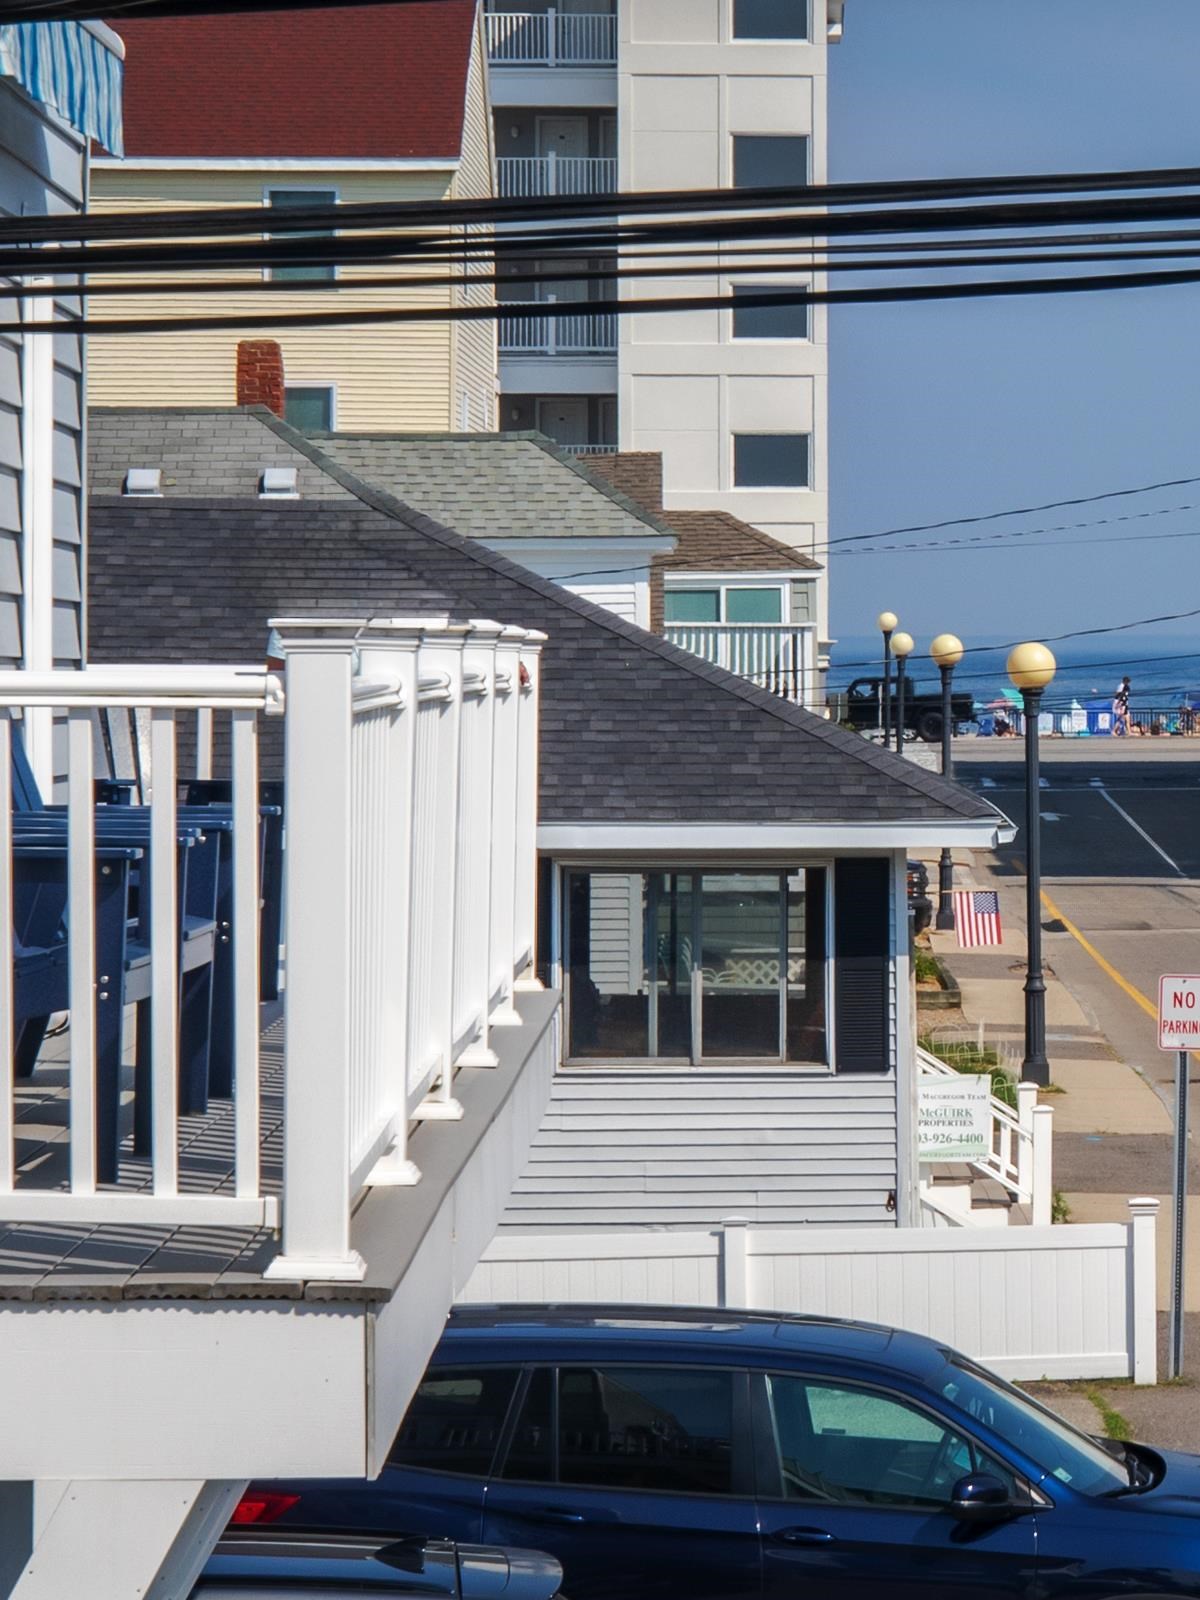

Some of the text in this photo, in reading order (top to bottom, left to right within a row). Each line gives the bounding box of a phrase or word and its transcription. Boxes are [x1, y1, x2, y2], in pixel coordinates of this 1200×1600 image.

[1173, 991, 1196, 1009] NO
[919, 1107, 974, 1118] McGUIRK
[918, 1119, 974, 1128] PROPERTIES
